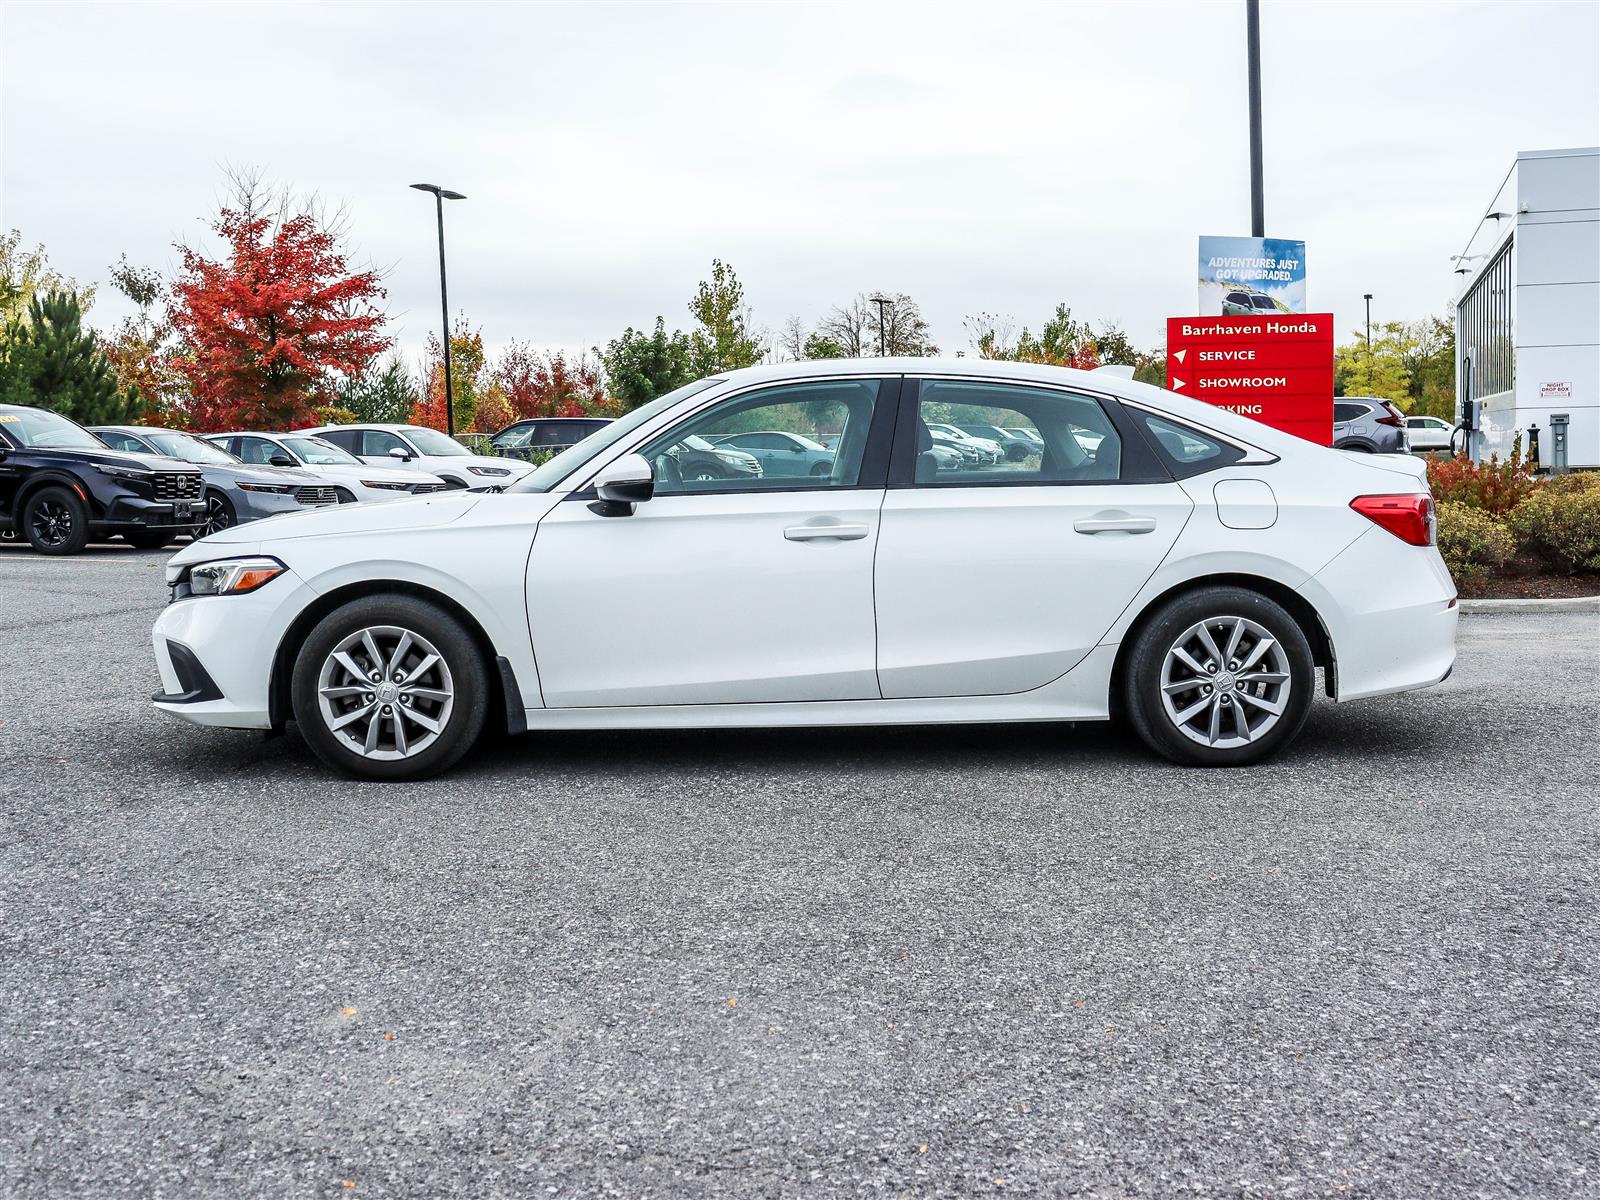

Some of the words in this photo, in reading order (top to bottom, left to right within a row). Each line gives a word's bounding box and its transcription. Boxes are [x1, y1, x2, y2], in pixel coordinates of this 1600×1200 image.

[1208, 257, 1276, 268] ADVENTURES
[1277, 259, 1298, 270] JUST
[1216, 269, 1238, 279] GOT
[1240, 269, 1293, 281] UPGRADED.
[1182, 324, 1261, 336] Barrhaven
[1266, 322, 1317, 334] Honda
[1199, 350, 1256, 361] SERVICE
[1199, 377, 1287, 388] SHOWROOM
